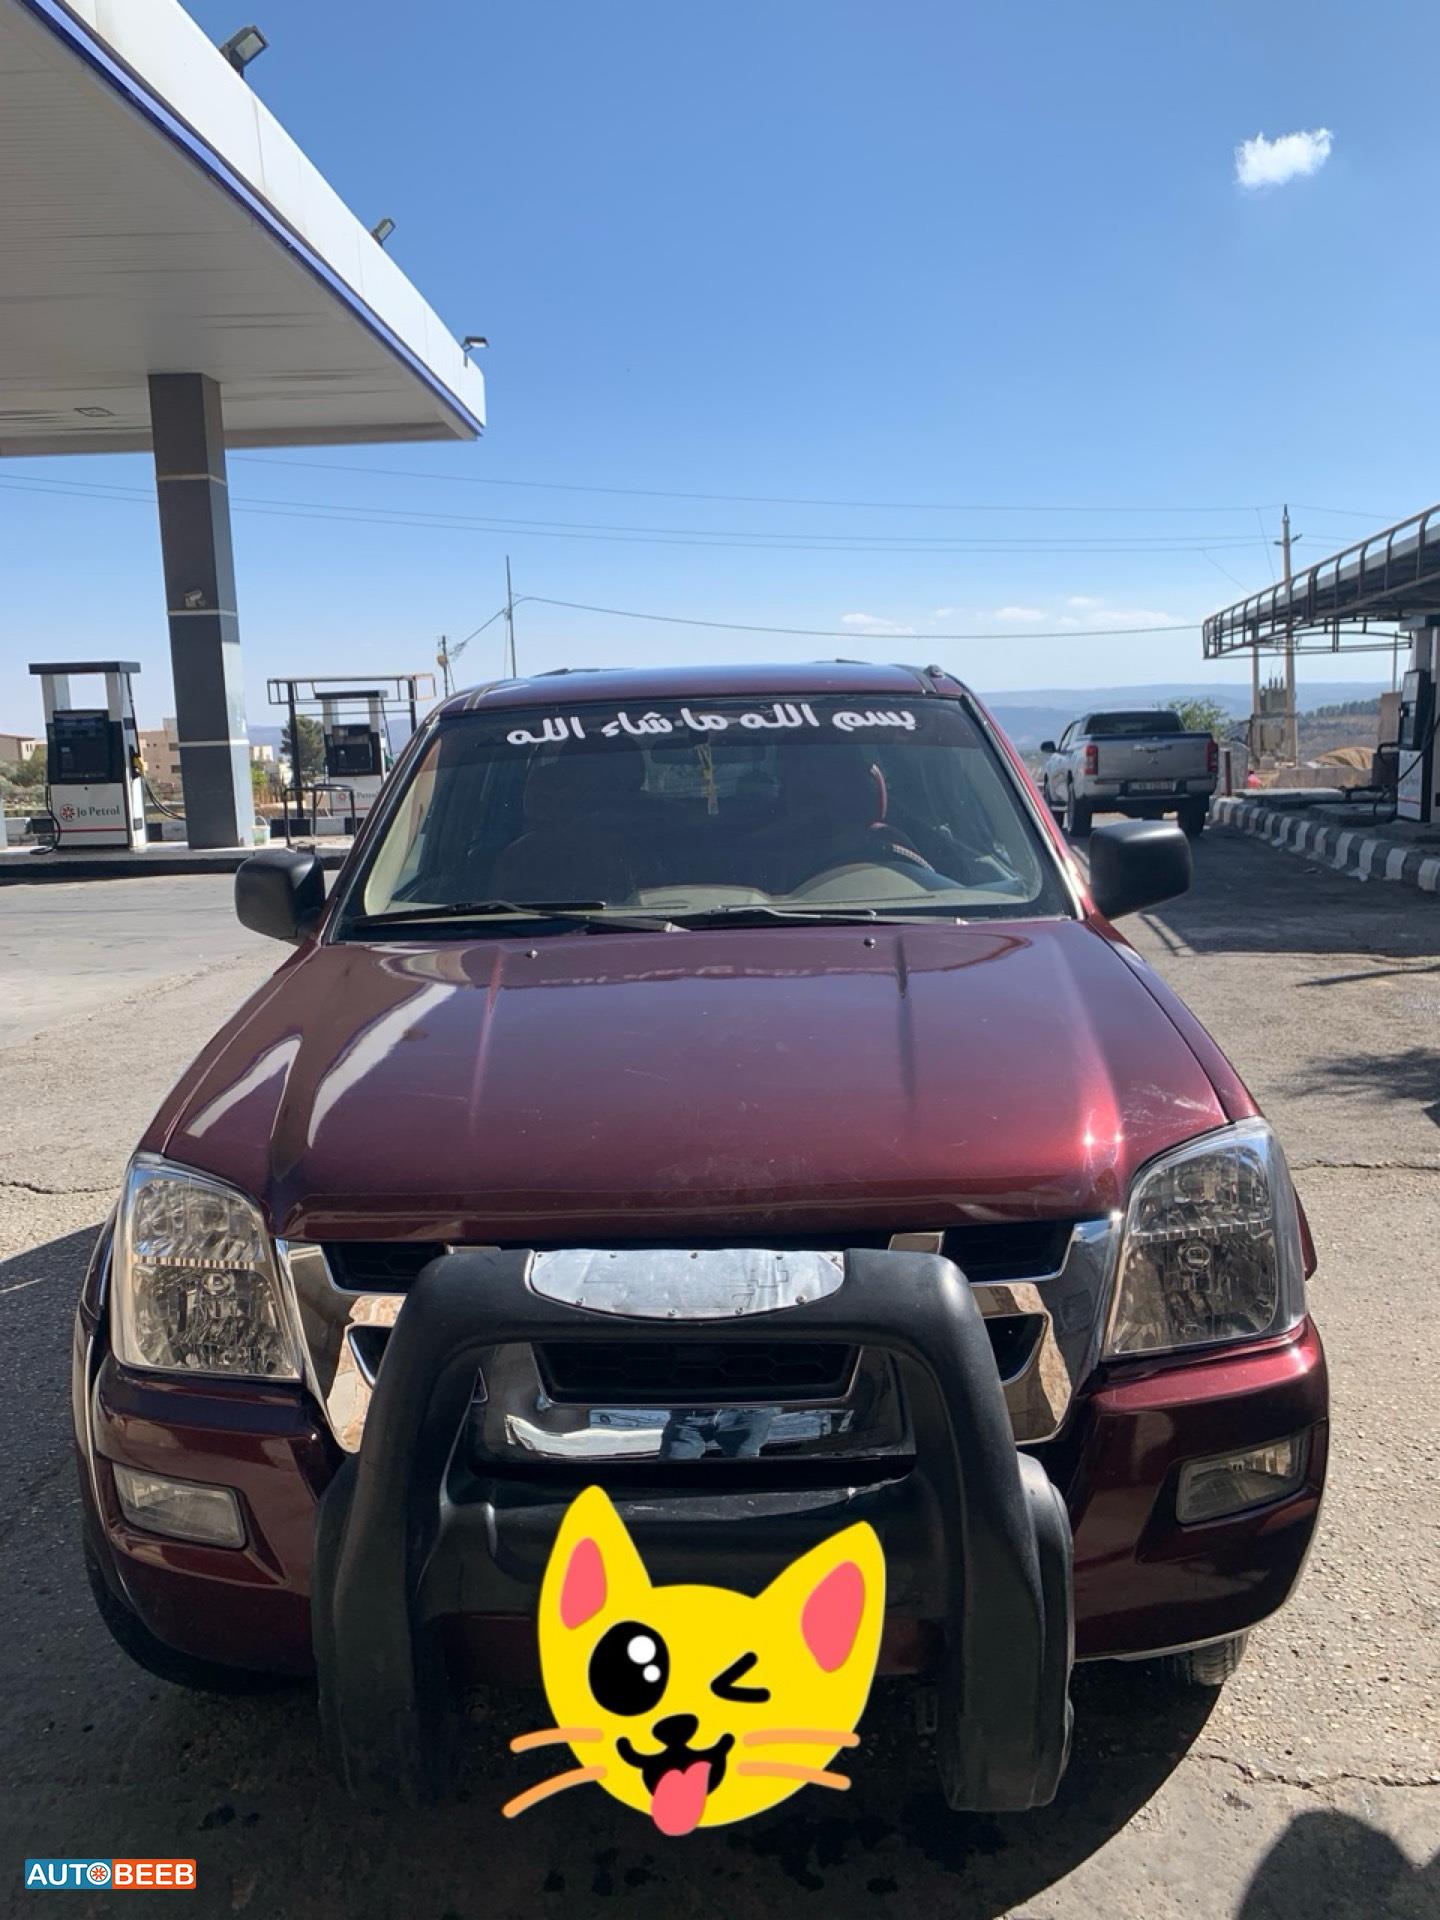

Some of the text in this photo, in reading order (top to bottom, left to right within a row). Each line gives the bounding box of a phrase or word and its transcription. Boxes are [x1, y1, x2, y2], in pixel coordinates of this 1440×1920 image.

[506, 703, 916, 745] بسم الله ما شاء الله
[77, 805, 120, 818] Jo Petrol
